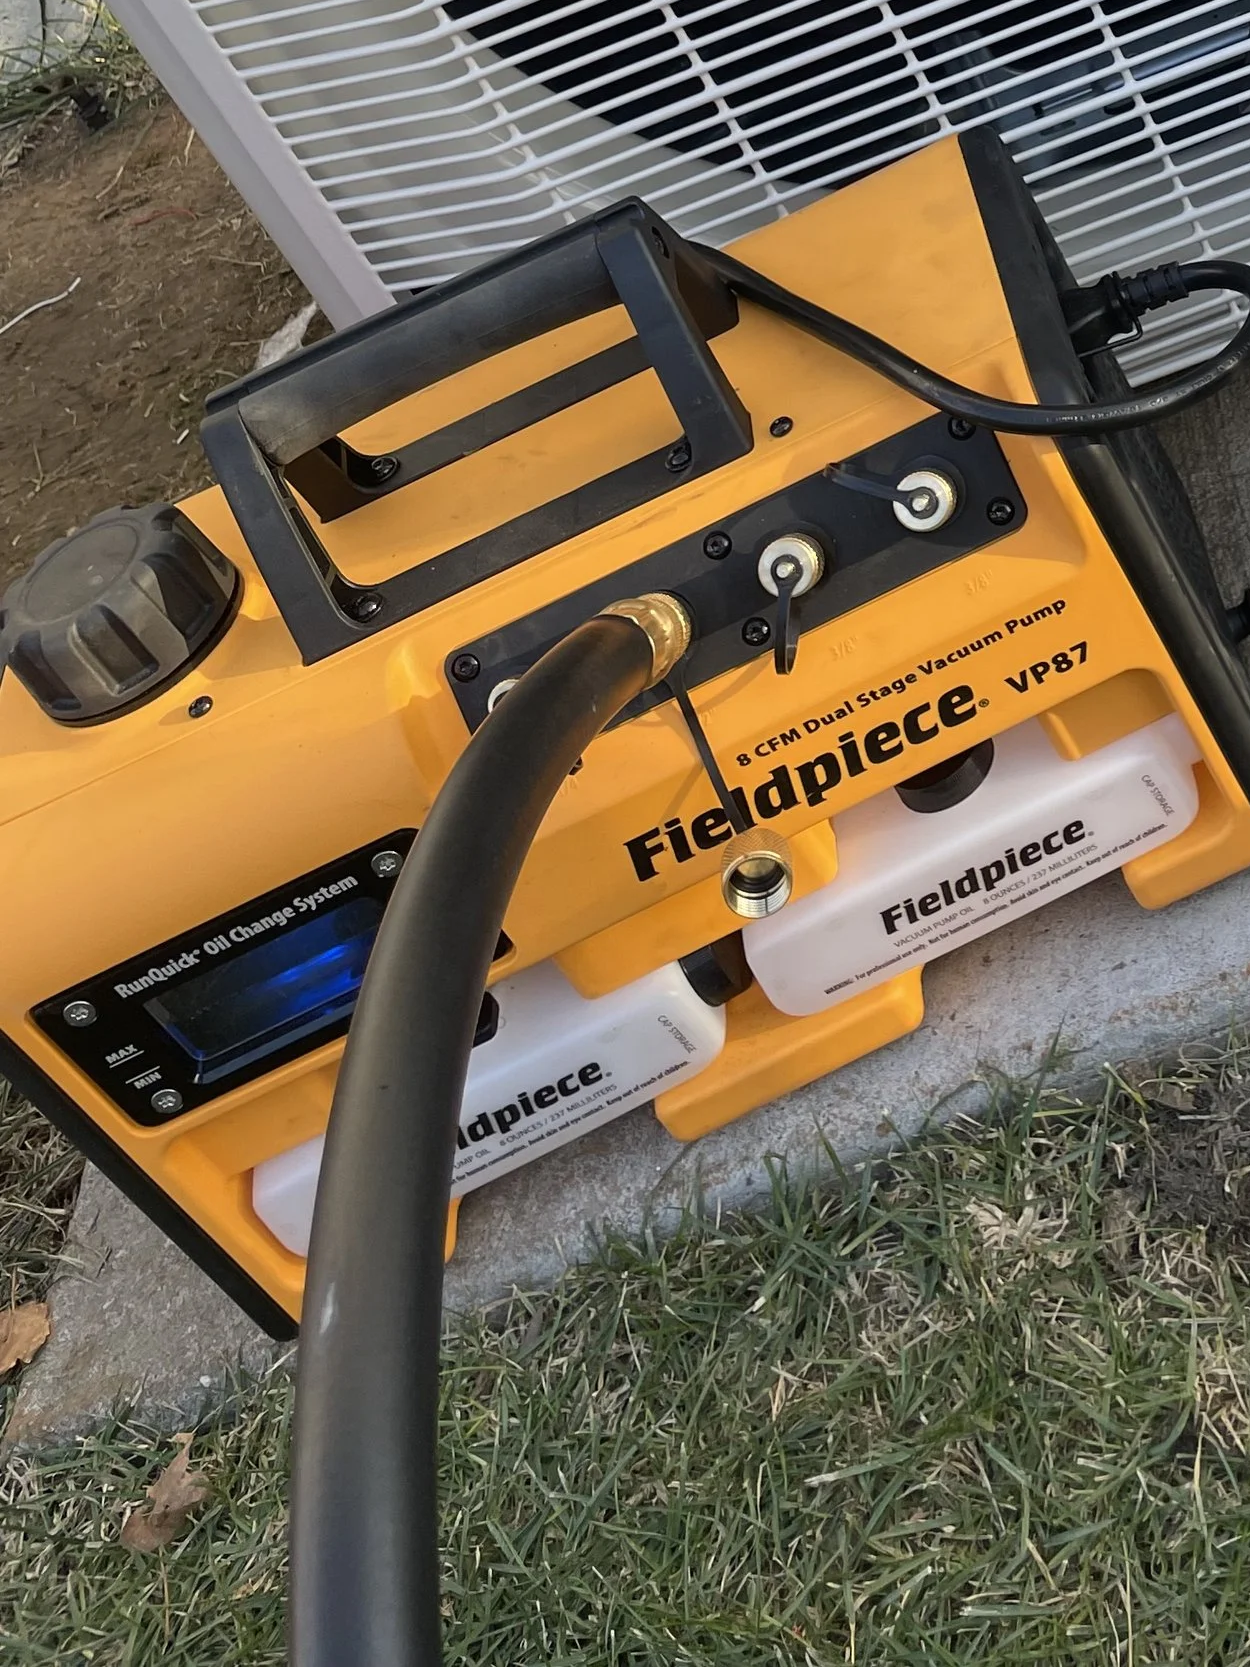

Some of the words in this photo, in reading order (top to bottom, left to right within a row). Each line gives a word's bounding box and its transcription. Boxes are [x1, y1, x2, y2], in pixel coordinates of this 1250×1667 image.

[736, 751, 751, 768] 8
[753, 728, 802, 759] CFM
[802, 701, 853, 735] Dual
[856, 670, 919, 710] Stage
[918, 629, 1003, 677] Vacuum
[1004, 598, 1067, 634] Pump
[623, 684, 977, 882] Fieldpiece
[1003, 640, 1089, 696] VP87
[1141, 774, 1156, 791] CAP
[1149, 787, 1175, 817] STORAGE
[880, 820, 1086, 935] Fieldpiece
[893, 925, 933, 948] VACUUM
[932, 912, 959, 932] PUMP
[959, 905, 976, 917] OIL
[990, 879, 1026, 902] OUNCES
[1031, 868, 1047, 881] 237
[1048, 843, 1098, 873] MILLILITERS
[1039, 880, 1051, 892] and
[1050, 876, 1062, 887] eye
[1101, 850, 1112, 860] out
[1119, 839, 1135, 851] reach
[113, 946, 200, 999] RunQuick
[203, 934, 232, 956] Oil
[228, 906, 296, 944] Change
[293, 875, 359, 913] System
[105, 1044, 139, 1065] MAX
[657, 1014, 672, 1029] CAP
[670, 1025, 697, 1055] STORAGE
[133, 1071, 163, 1090] MIN
[456, 1061, 603, 1151] ldpiece
[475, 1147, 492, 1160] OIL
[505, 1121, 543, 1143] OUNCES
[549, 1109, 566, 1123] 237
[566, 1083, 618, 1112] MILLILITERS
